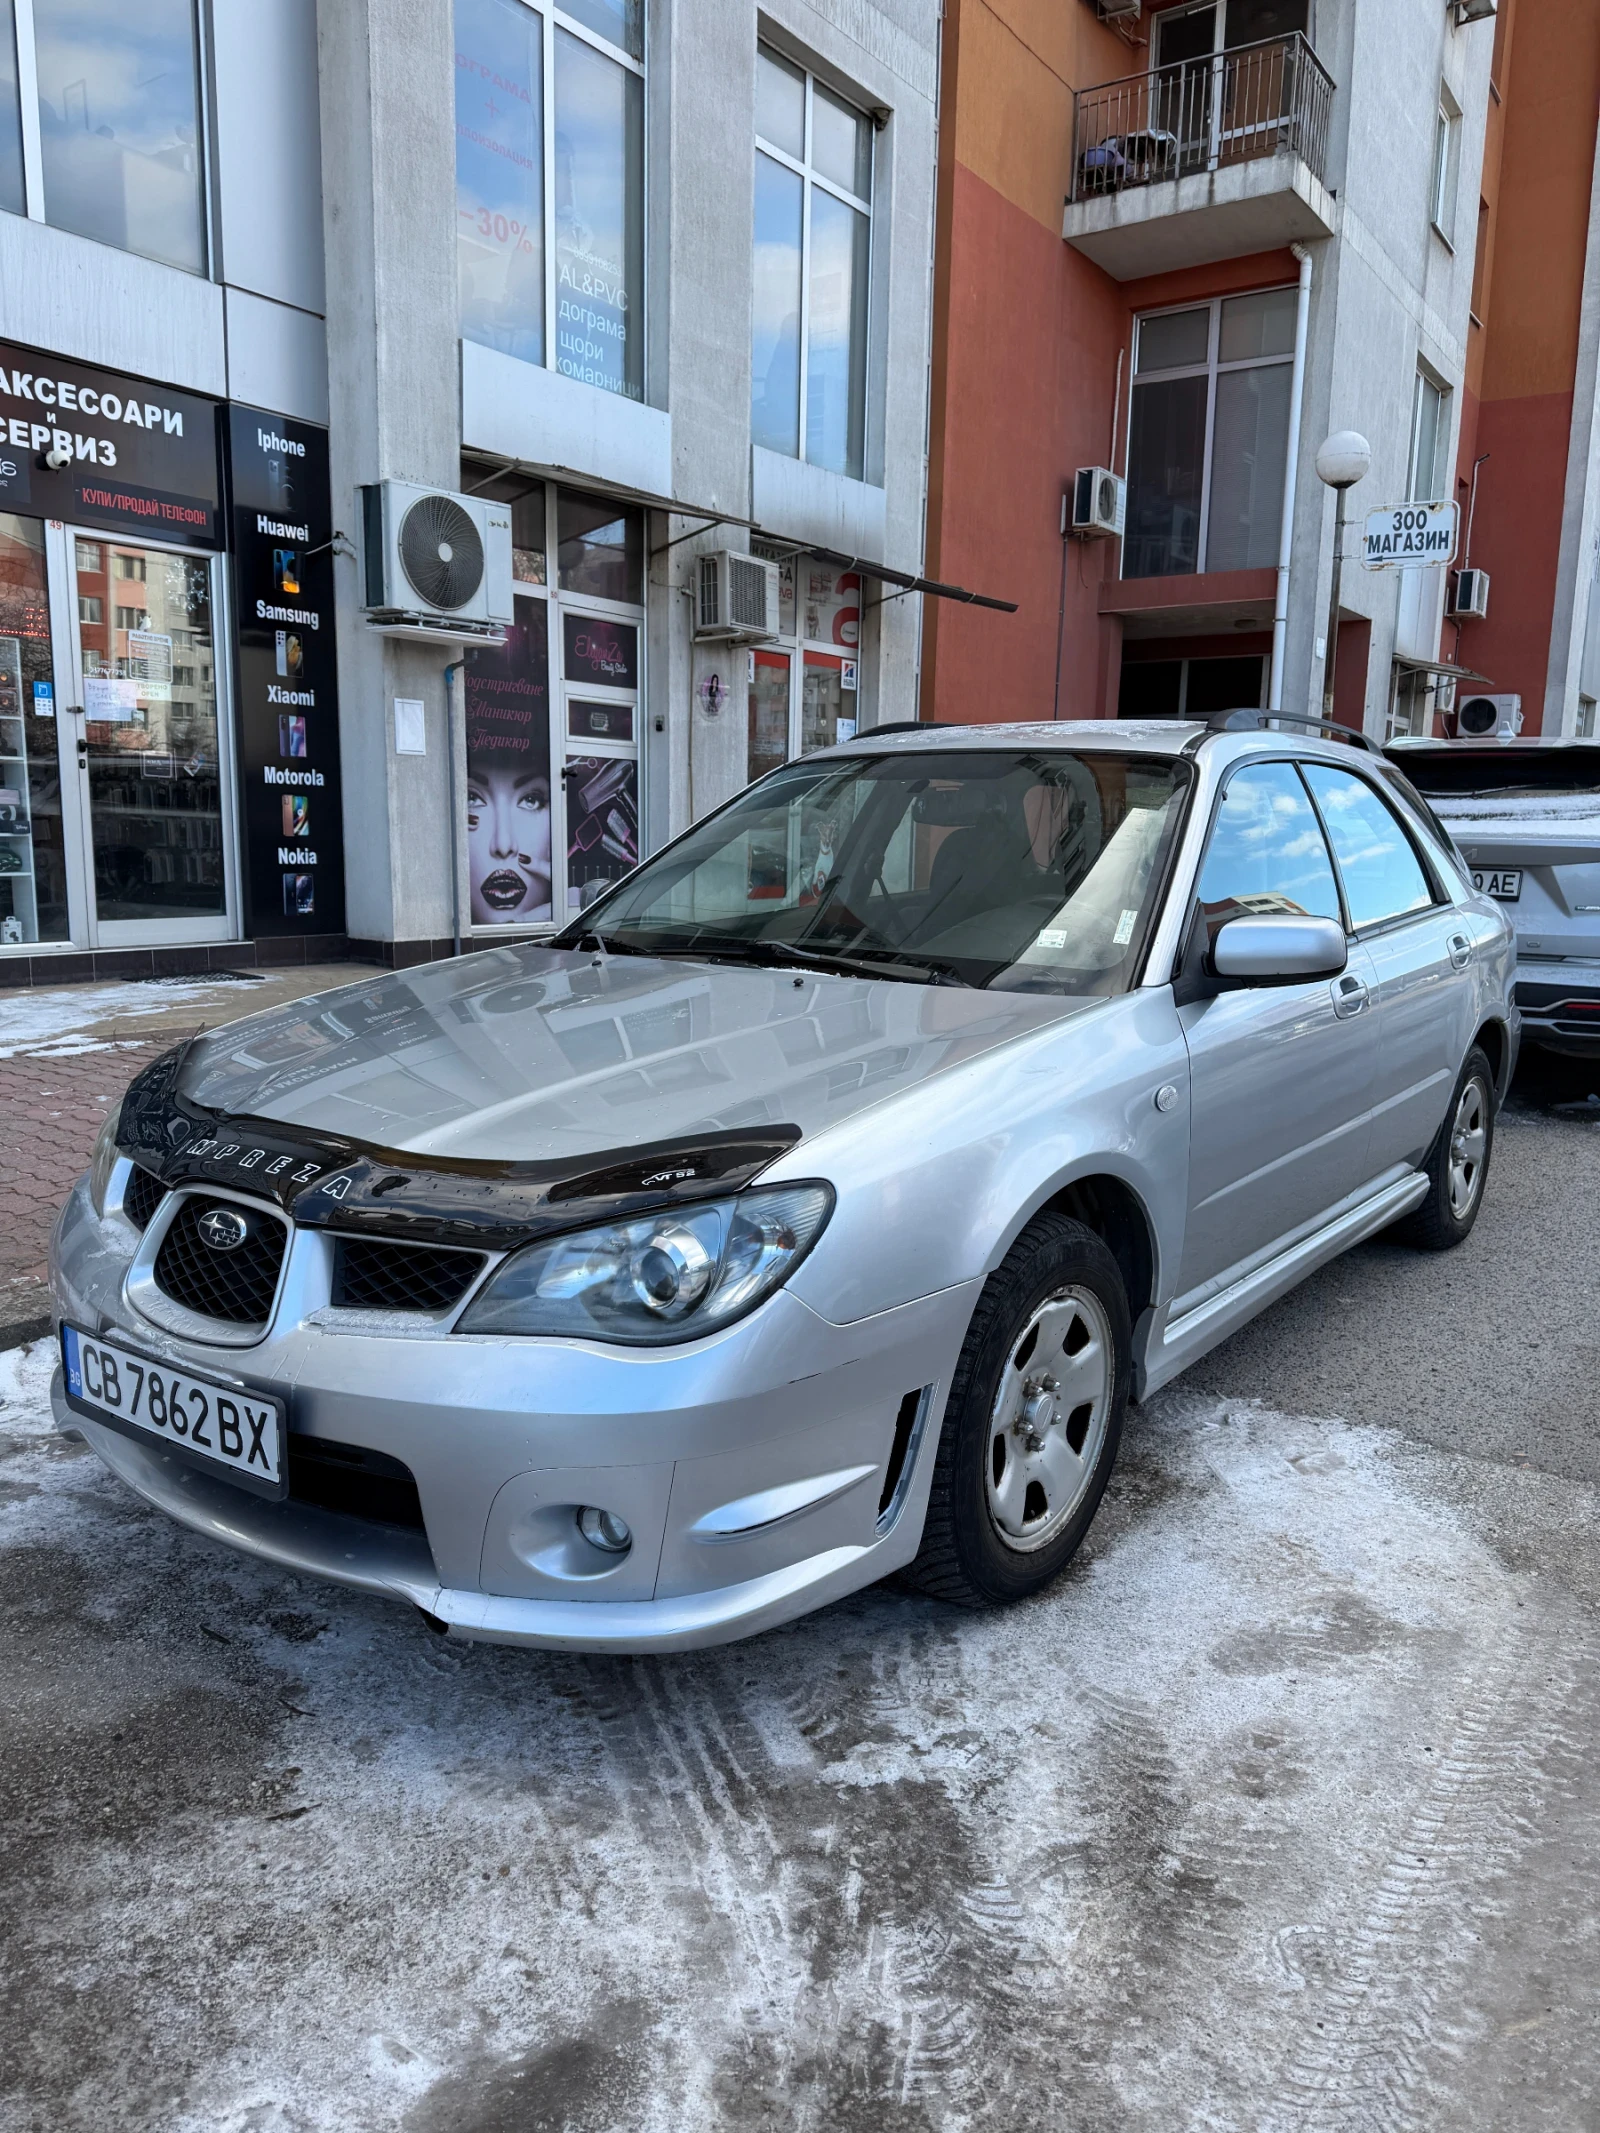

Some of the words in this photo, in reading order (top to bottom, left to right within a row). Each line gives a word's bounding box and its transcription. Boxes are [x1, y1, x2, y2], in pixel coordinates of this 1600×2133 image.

[559, 263, 629, 312] AL&PVC
[559, 299, 627, 341] дограма
[560, 330, 604, 362] щори
[0, 366, 184, 437] АКСЕСОАРИ
[257, 428, 306, 458] Iphone
[82, 487, 159, 517] КУПИ/ПРОДАЙ
[160, 503, 207, 525] ТЕЛЕФОН
[257, 514, 309, 542] Huawei
[1367, 530, 1450, 554] МАГАЗИН
[256, 600, 319, 630] Samsung
[267, 684, 315, 707] Xiaomi
[263, 765, 325, 787] Motorola
[277, 847, 318, 866] Nokia
[69, 1366, 81, 1385] BG
